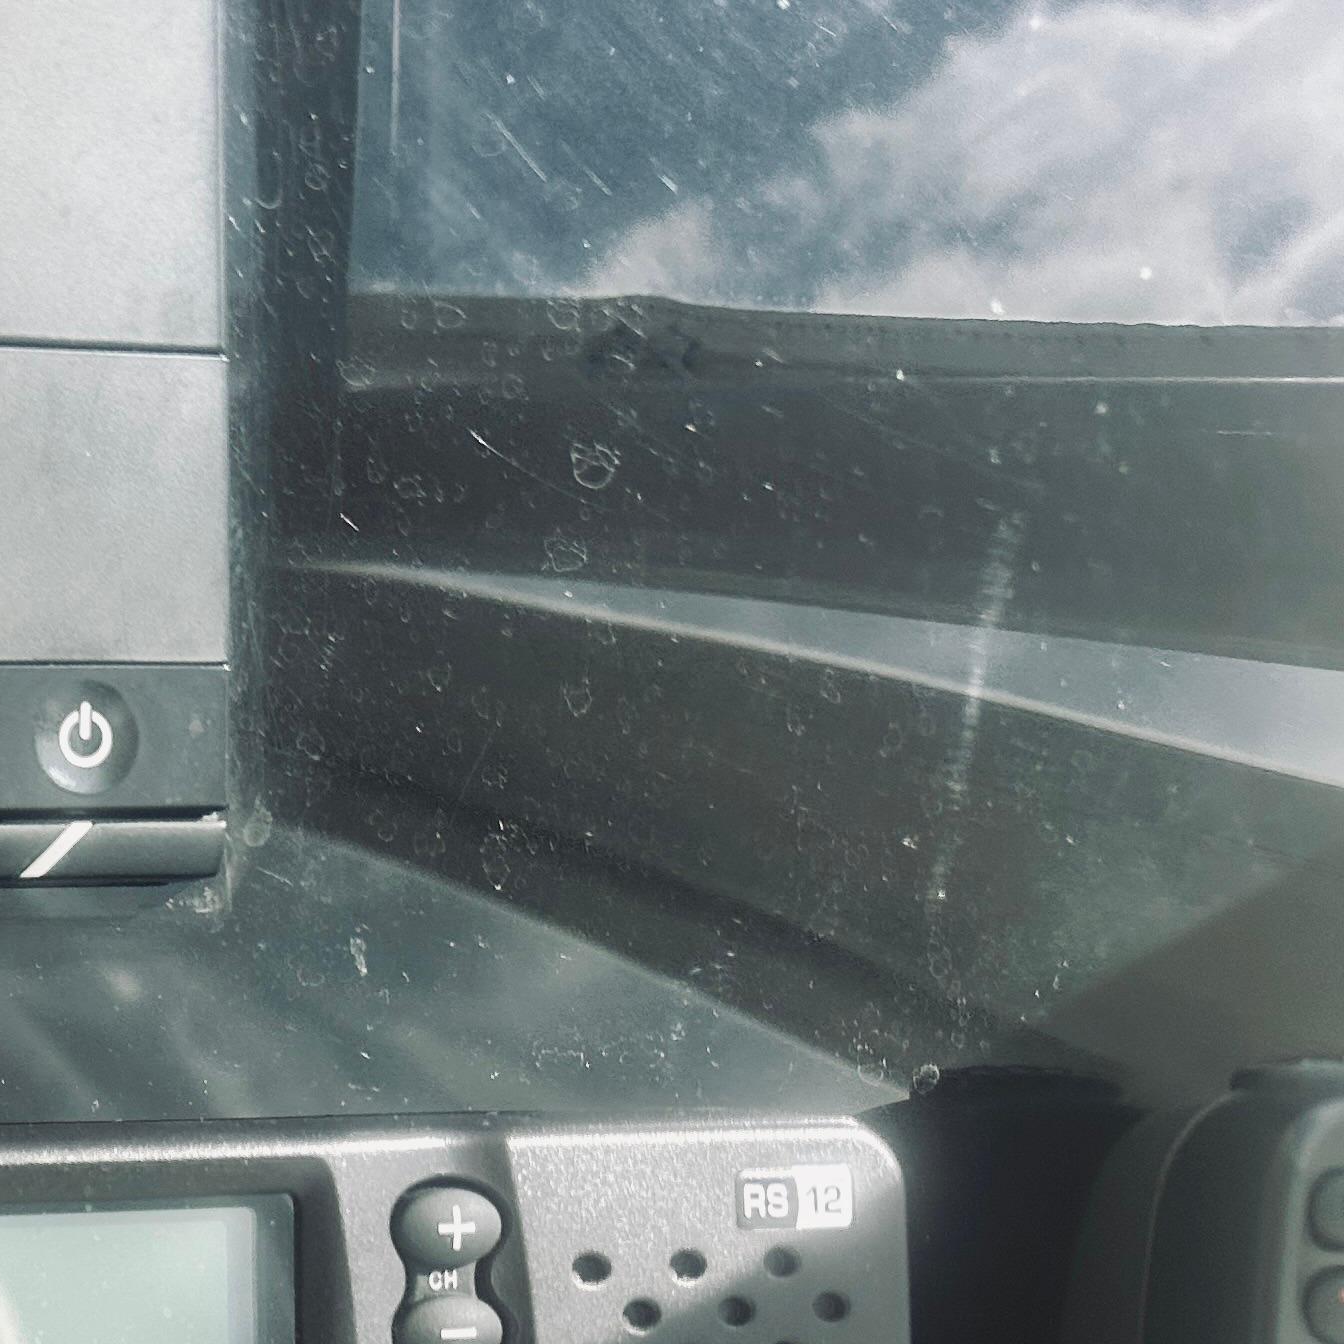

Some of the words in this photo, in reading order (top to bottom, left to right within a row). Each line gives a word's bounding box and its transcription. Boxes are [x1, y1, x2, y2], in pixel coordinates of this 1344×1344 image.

[743, 1184, 789, 1218] RS
[805, 1183, 843, 1215] 12
[428, 1270, 458, 1291] CH
